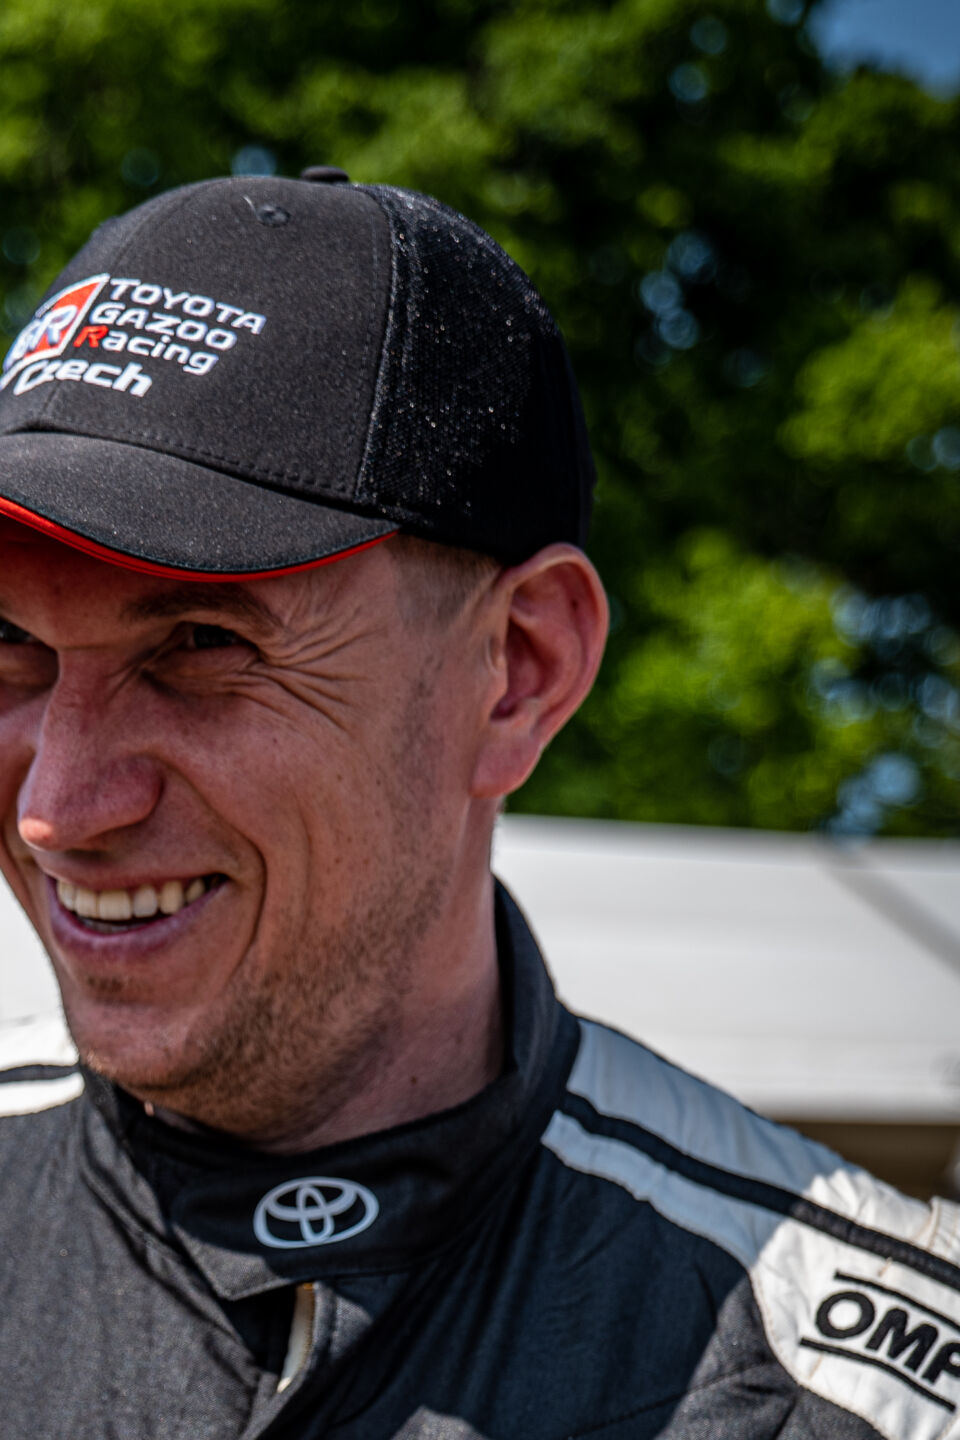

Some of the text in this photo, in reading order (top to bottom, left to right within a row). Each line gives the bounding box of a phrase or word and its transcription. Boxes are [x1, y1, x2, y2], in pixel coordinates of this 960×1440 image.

[90, 301, 237, 351] GAZOO
[109, 277, 267, 335] TOYOTA
[73, 325, 220, 376] Racing
[13, 358, 153, 397] Czech
[814, 1290, 960, 1385] OMP
